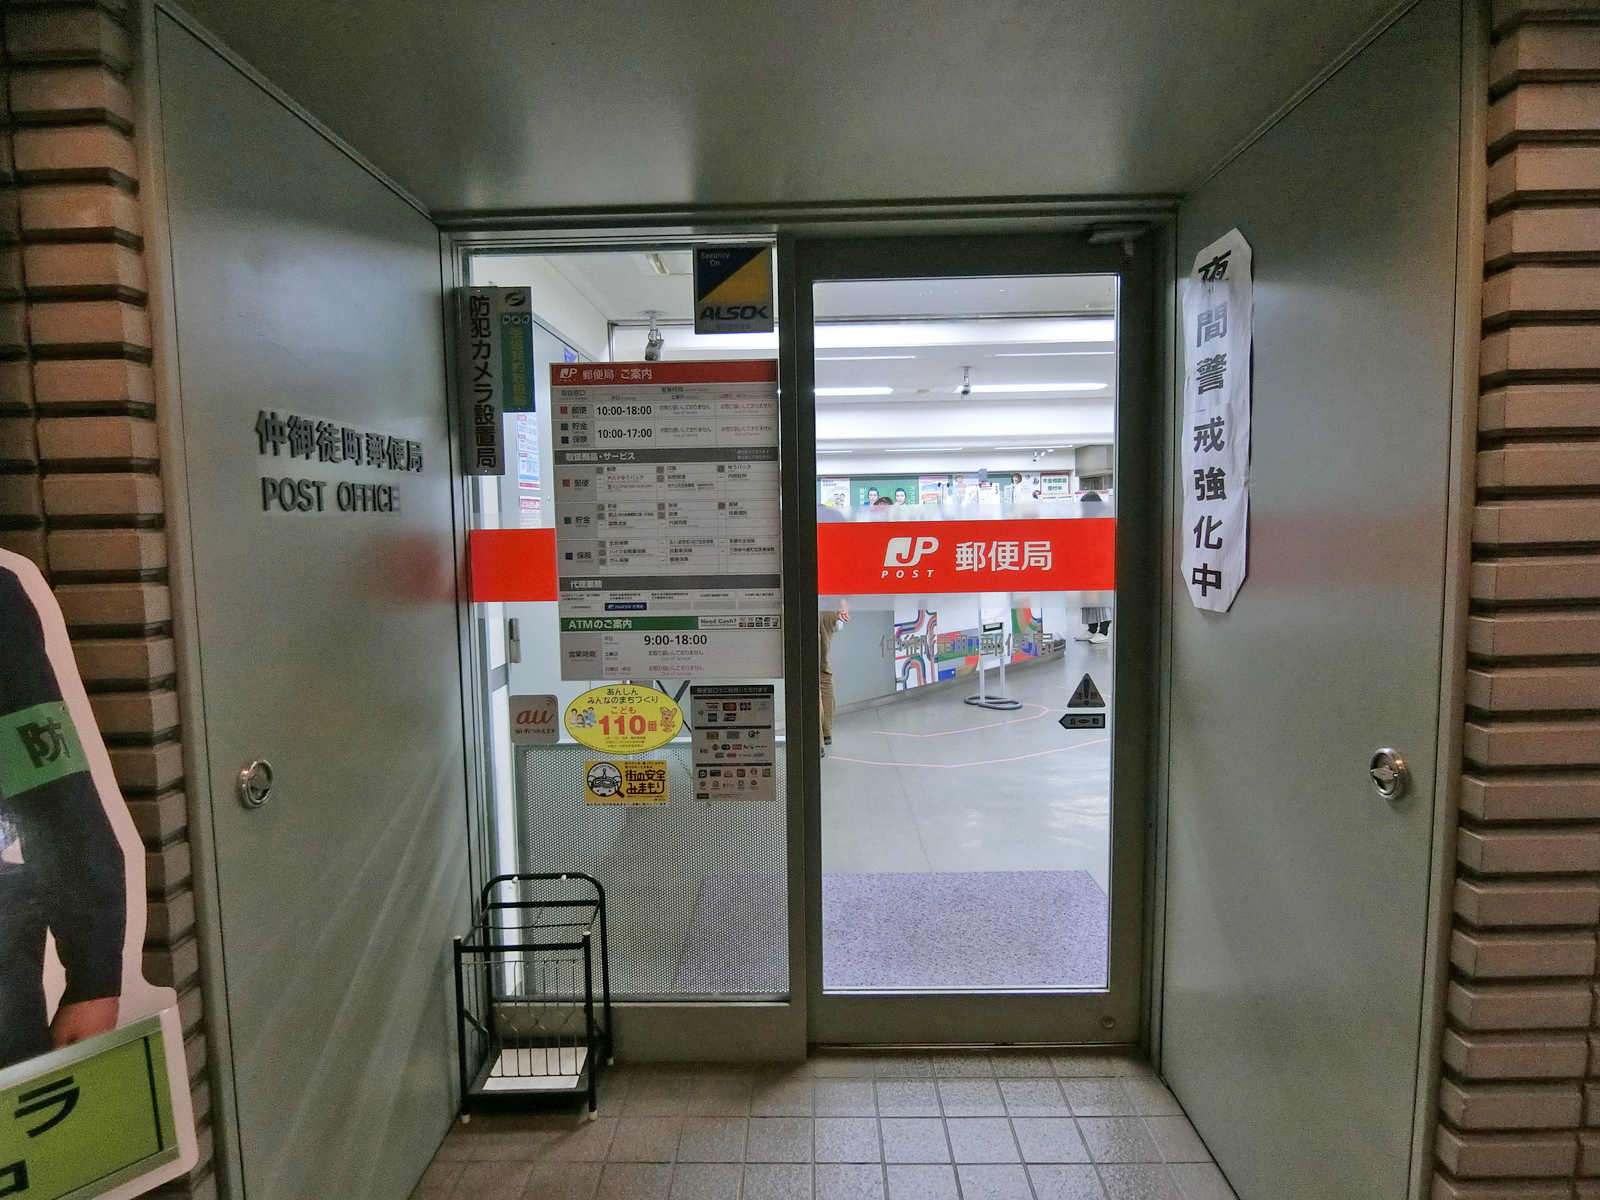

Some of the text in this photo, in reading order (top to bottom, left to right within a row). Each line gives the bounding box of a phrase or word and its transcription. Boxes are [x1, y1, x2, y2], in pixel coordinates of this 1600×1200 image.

[701, 252, 730, 260] Security
[701, 305, 769, 320] ALSOK
[582, 369, 614, 380] 郵便局
[621, 368, 652, 380] ご案内
[469, 295, 497, 469] 防犯カメラ設置局
[572, 406, 587, 415] 郵便
[597, 405, 652, 416] 10:00-18:00
[1191, 249, 1231, 597] 夜間警戒強化中
[597, 428, 653, 439] 10:00-17:00
[255, 409, 424, 473] 仲御徒町郵便局
[260, 476, 401, 512] POST OFFICE
[955, 540, 1053, 572] 郵便局
[881, 569, 934, 579] POST
[568, 618, 632, 630] ATMのご案内
[644, 634, 708, 646] 9:00-18:00
[606, 687, 639, 696] あんしん
[611, 705, 637, 715] こども
[516, 710, 554, 725] au
[624, 769, 666, 782] 街の安全
[626, 782, 665, 795] みまもり
